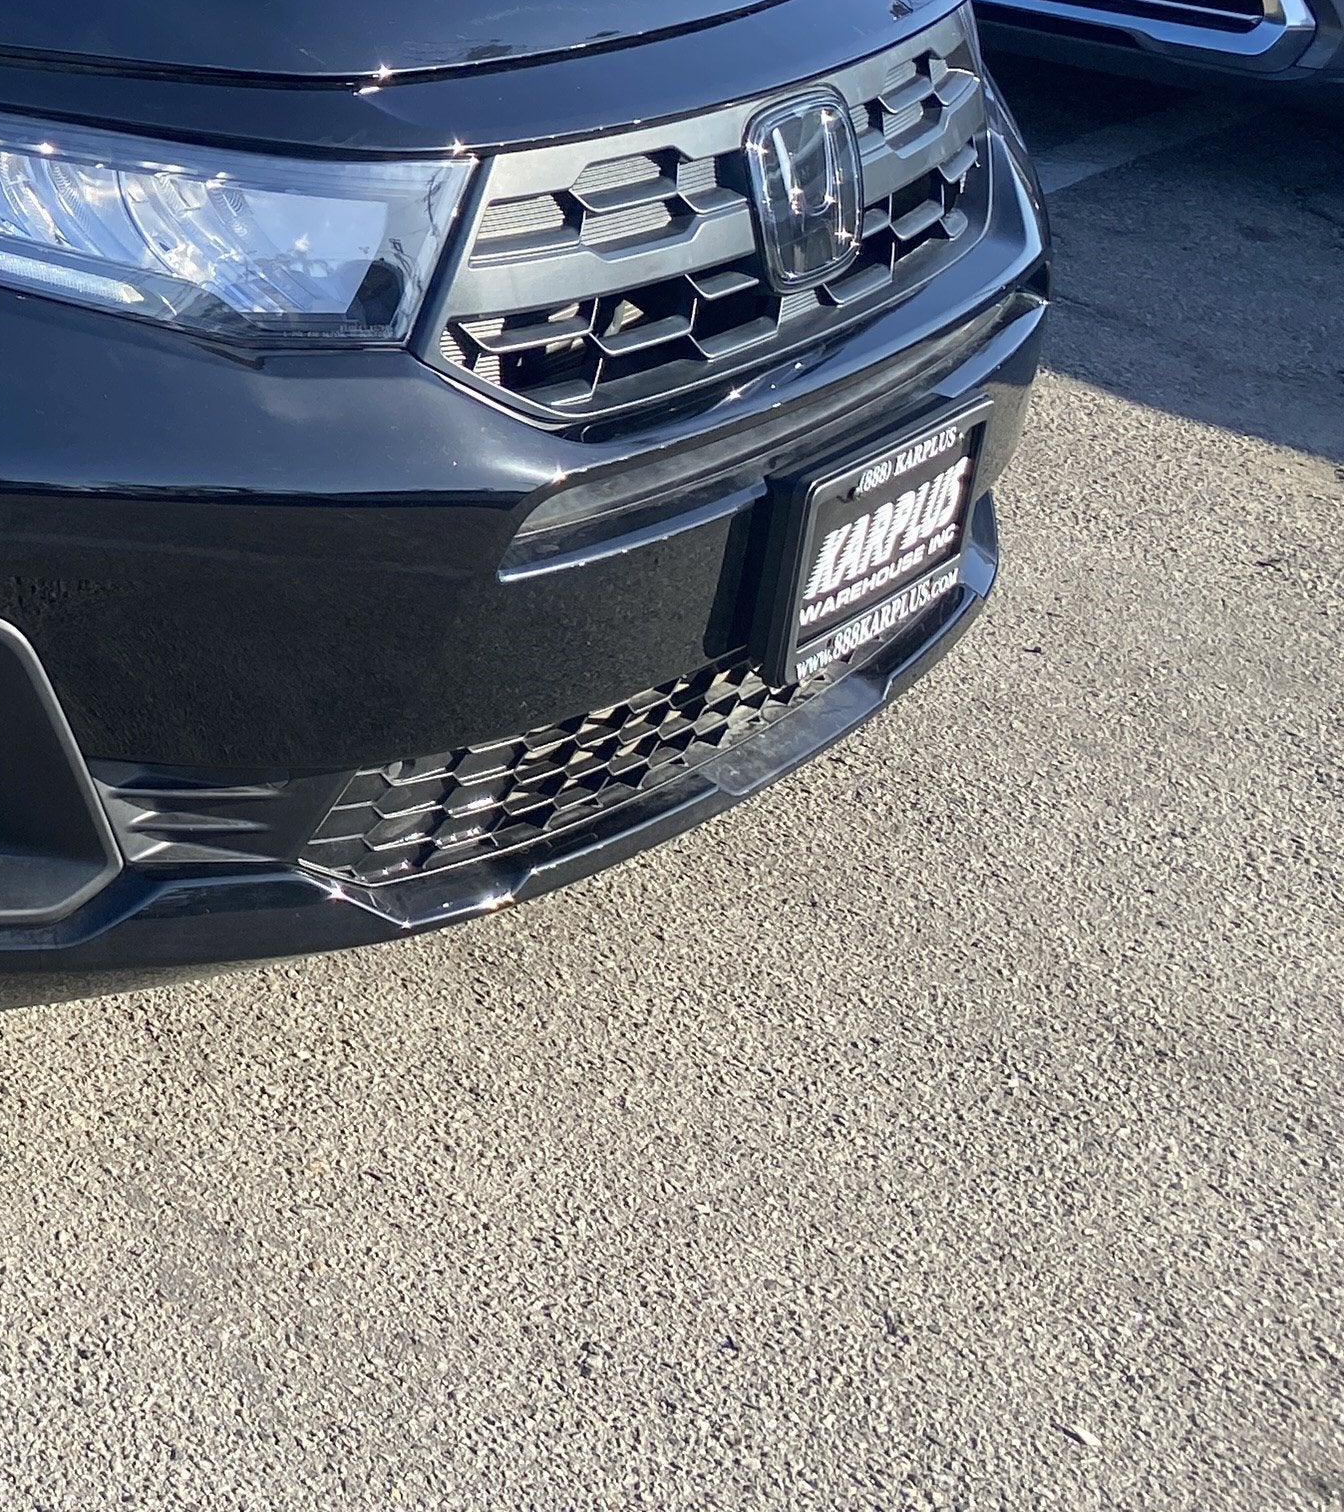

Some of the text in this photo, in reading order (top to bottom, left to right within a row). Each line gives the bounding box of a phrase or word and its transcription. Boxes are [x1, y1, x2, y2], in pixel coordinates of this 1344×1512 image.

[859, 426, 958, 493] (888) KARPLUS
[799, 523, 958, 627] WAREHOUSE INC
[802, 456, 969, 600] KARPLUS
